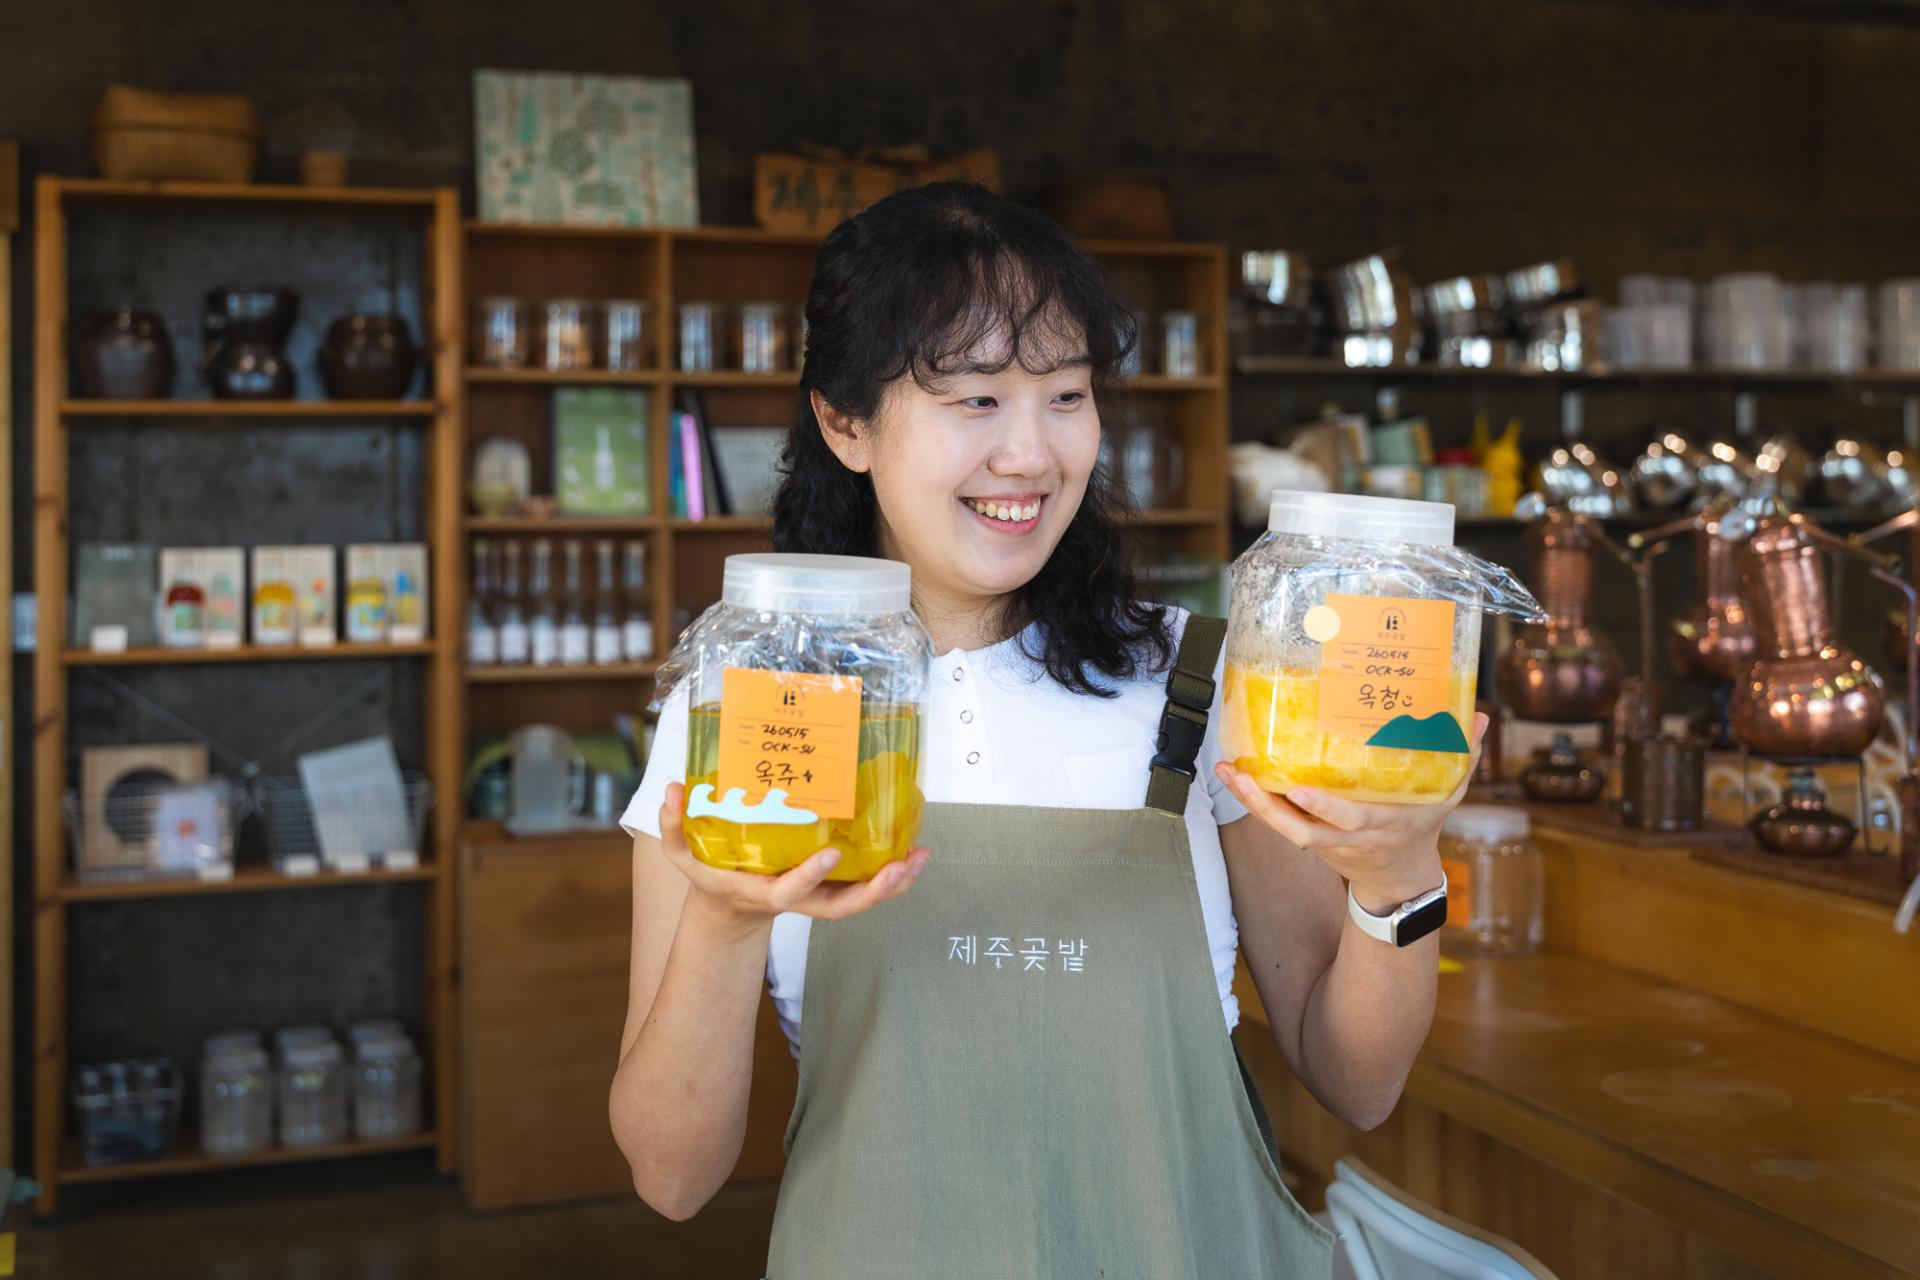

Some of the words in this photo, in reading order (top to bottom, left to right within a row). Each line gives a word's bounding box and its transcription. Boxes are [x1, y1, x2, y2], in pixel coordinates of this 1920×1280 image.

[1366, 647, 1410, 661] 260515
[1365, 664, 1416, 677] OCK-SU
[1358, 683, 1400, 711] 옥청
[762, 724, 810, 739] 260515
[756, 760, 799, 787] 옥주
